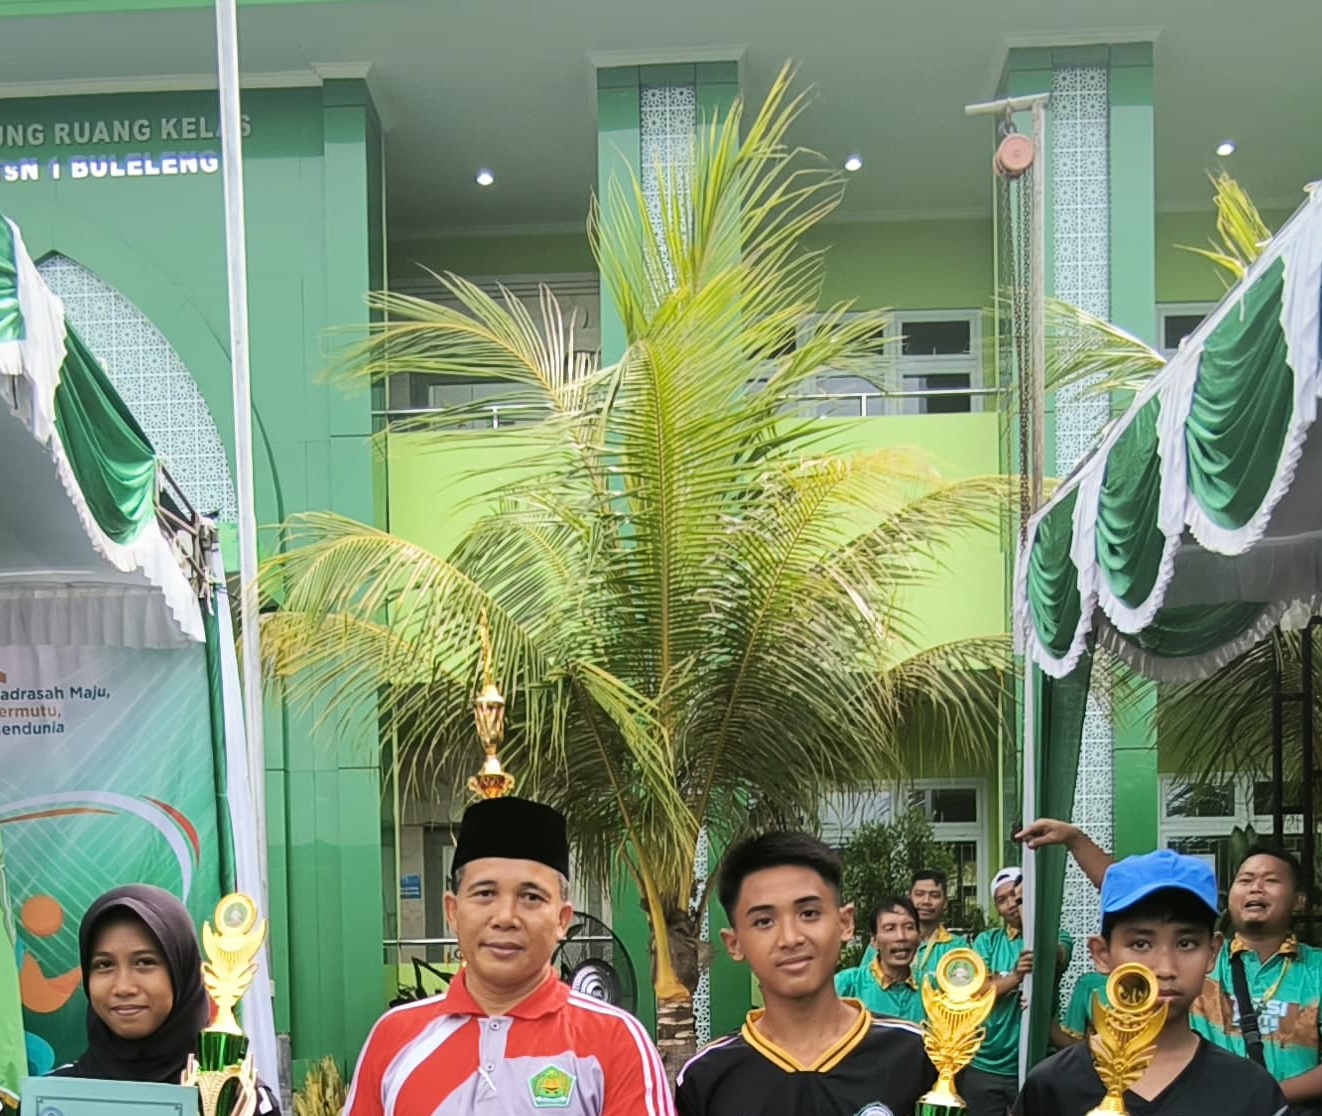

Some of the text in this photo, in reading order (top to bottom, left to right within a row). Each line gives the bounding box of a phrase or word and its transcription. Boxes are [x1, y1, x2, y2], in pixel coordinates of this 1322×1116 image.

[54, 118, 152, 145] RUANG
[71, 150, 219, 178] BULELENG
[70, 685, 110, 701] Maju,
